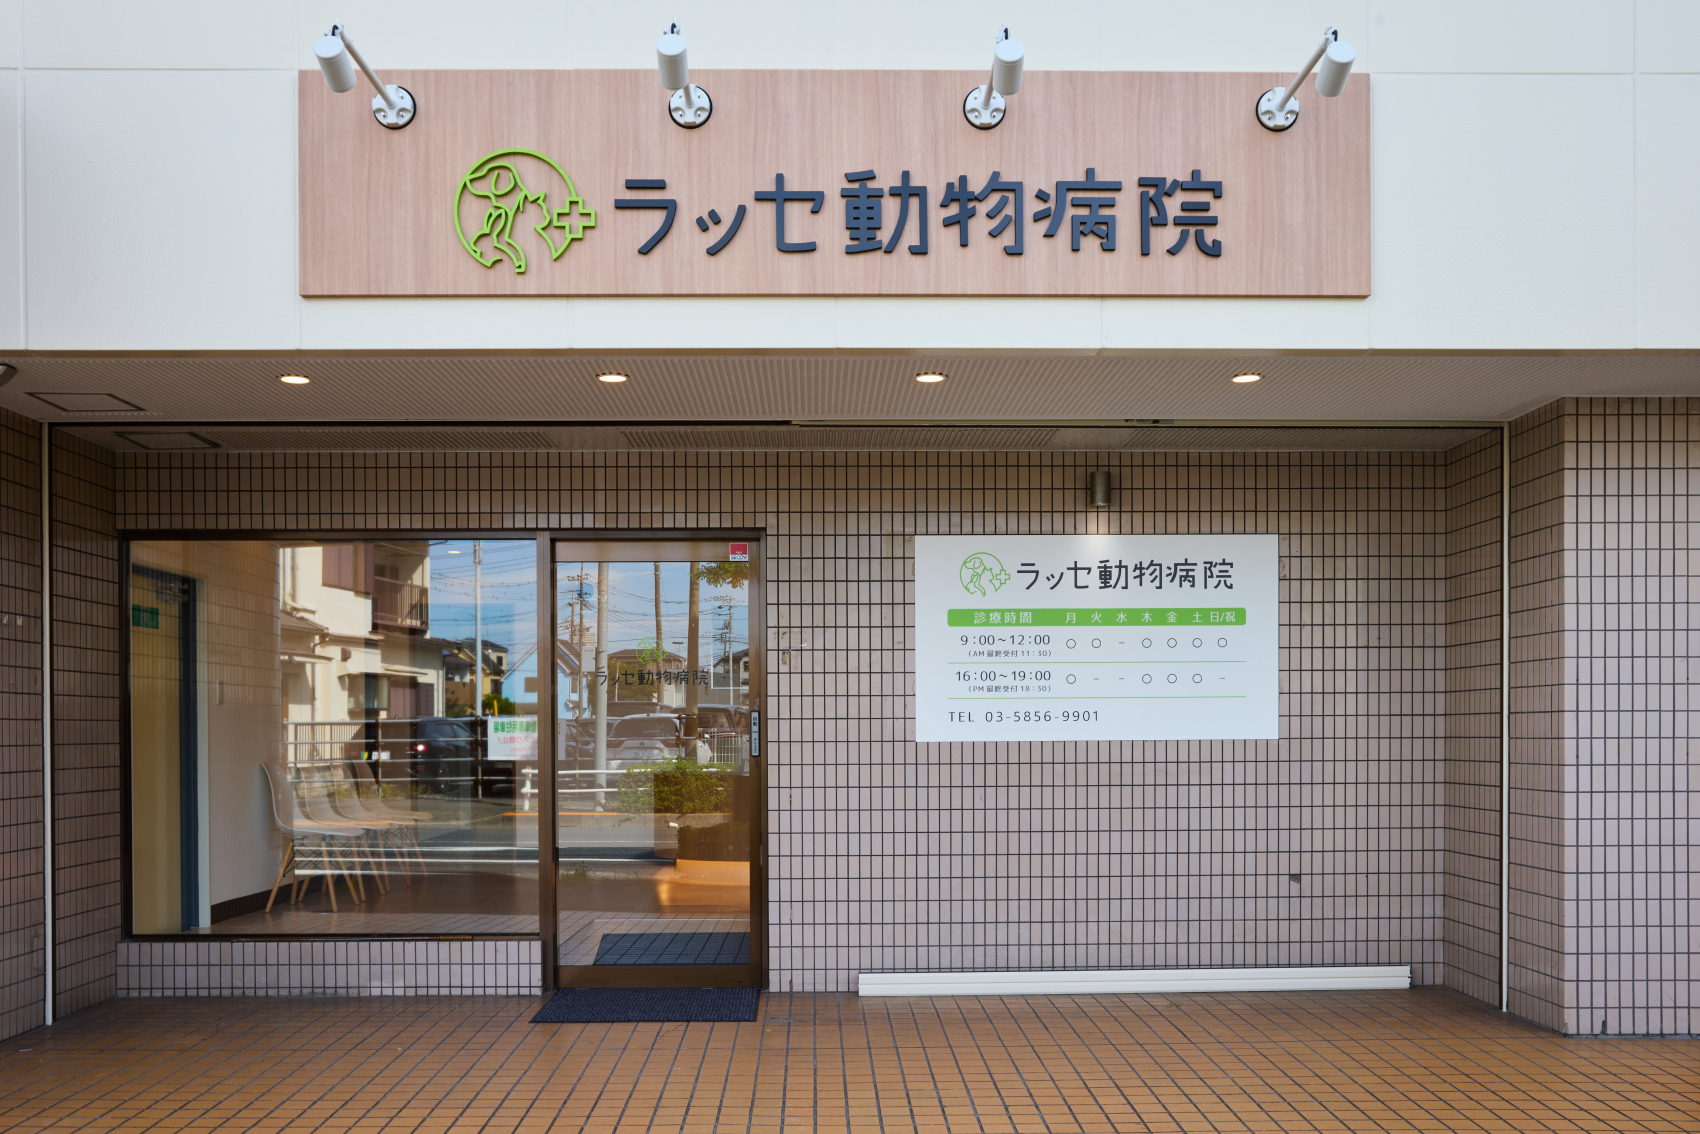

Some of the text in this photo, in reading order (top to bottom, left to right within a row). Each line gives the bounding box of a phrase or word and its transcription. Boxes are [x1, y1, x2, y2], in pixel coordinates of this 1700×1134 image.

[614, 168, 1223, 257] ラッセ動物病院
[1016, 558, 1234, 590] ラッセ動物病院
[973, 611, 1236, 624] 診療時間 月 火 水 木 金 土 日/祝
[595, 669, 709, 686] ラッセ動物病院
[948, 710, 1100, 723] TEL 03-5856-9901
